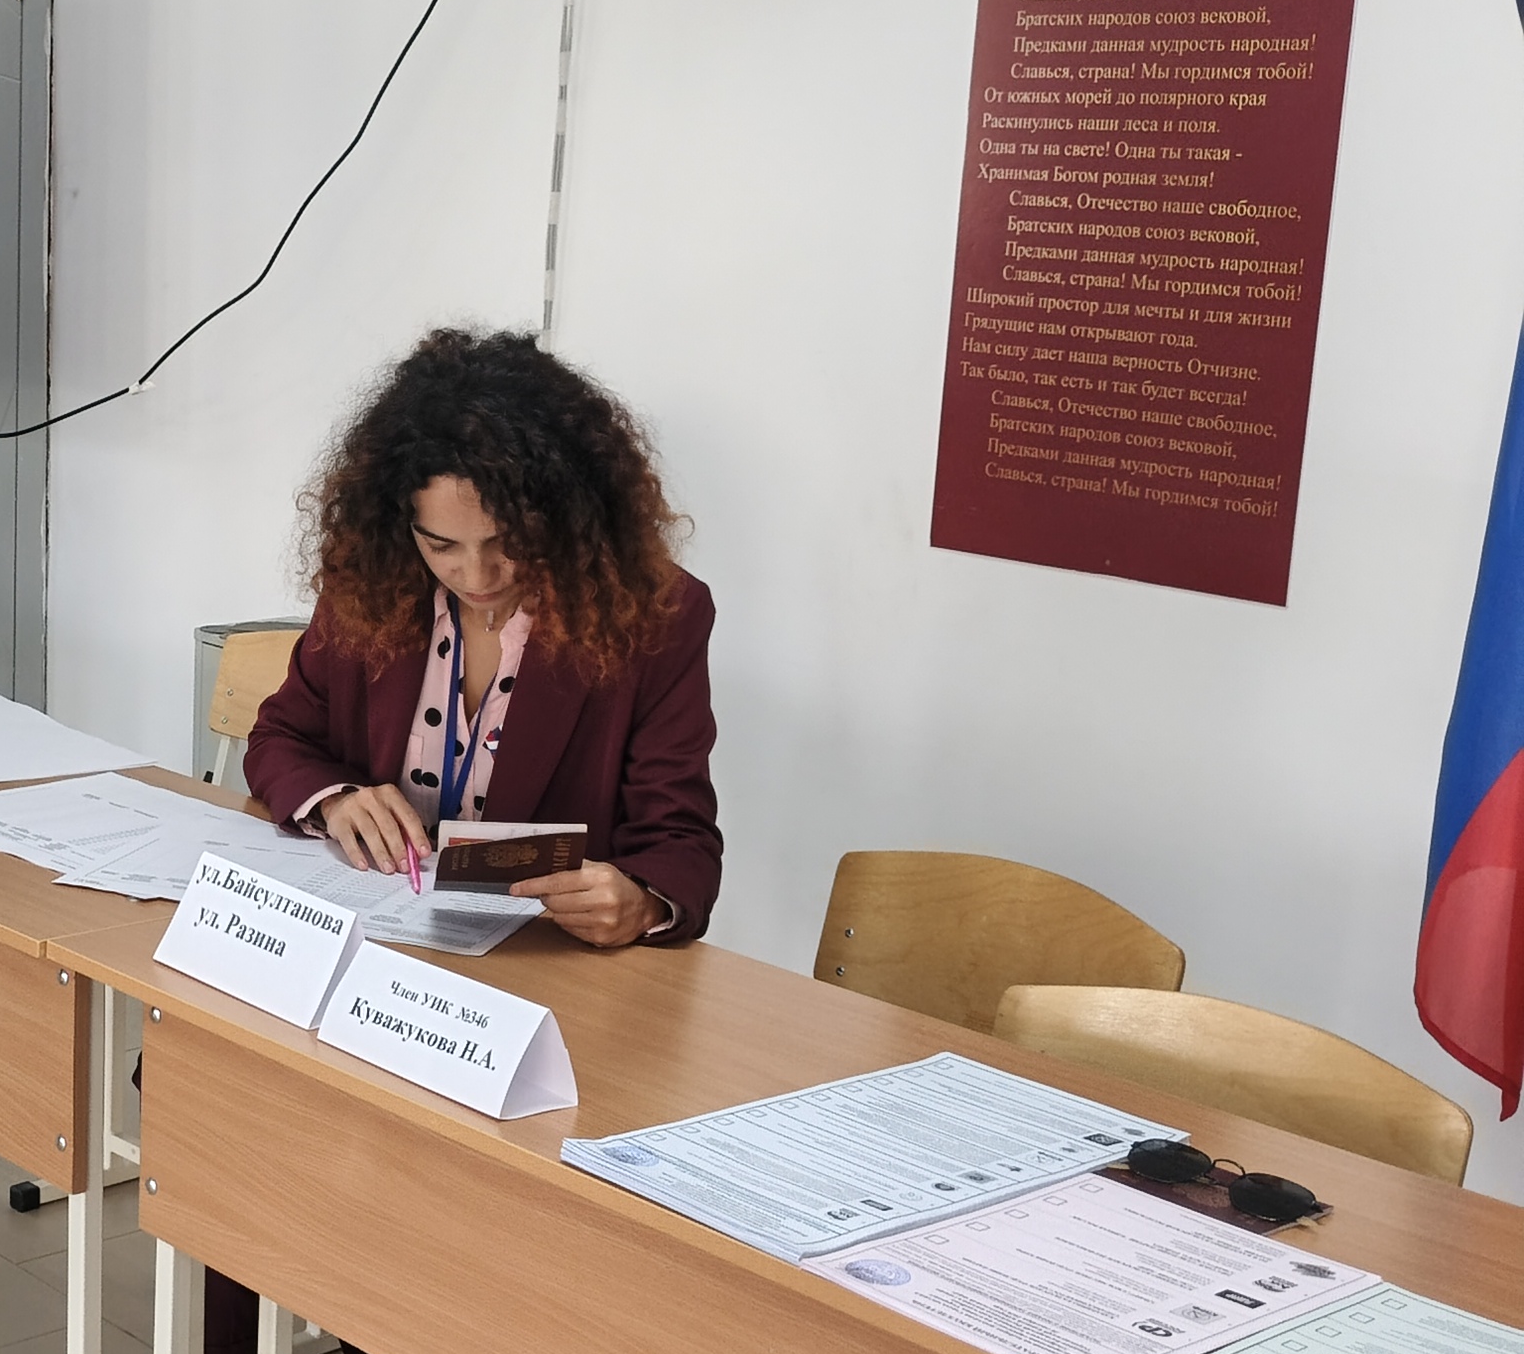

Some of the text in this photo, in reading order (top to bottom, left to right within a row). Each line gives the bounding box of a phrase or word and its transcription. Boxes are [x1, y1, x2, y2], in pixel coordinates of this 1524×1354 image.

[1014, 5, 1271, 31] Братских народов союз вековой,
[1012, 32, 1316, 57] Предками данная мудрость народная!
[1009, 61, 1314, 84] Славься, страна! Мы гордимся тобой!
[983, 85, 1267, 111] От южных морей до полярного края
[981, 111, 1220, 133] Раскинулись наши леса и поля.
[978, 136, 1231, 161] Одна ты на свете! Одна ты такая
[976, 162, 1215, 188] Хранимая Богом родная земля!
[1008, 188, 1301, 222] Славься, Отечество наше свободное,
[1006, 214, 1260, 247] Братских народов союз вековой,
[1003, 239, 1304, 276] Предками данная мудрость народная!
[1001, 263, 1302, 301] Славься, страна! Мы гордимся тобой!
[965, 286, 1292, 329] Широкий простор для мечты и для жизни
[963, 310, 1198, 348] Грядущие нам открывают года.
[961, 335, 992, 354] Нам
[993, 342, 1029, 362] силу
[1067, 349, 1108, 366] наша
[1111, 354, 1183, 373] верность
[1186, 357, 1261, 381] Отчизне.
[958, 359, 1247, 407] Так было, так есть и так будет всегда!
[990, 388, 1277, 438] Славься, Отечество наше свободное,
[988, 411, 1237, 461] Братских народов союз вековой,
[193, 906, 286, 958] ул. Разина
[390, 980, 490, 1030] Член УИК №346
[349, 996, 497, 1072] Куважукова Н.А.
